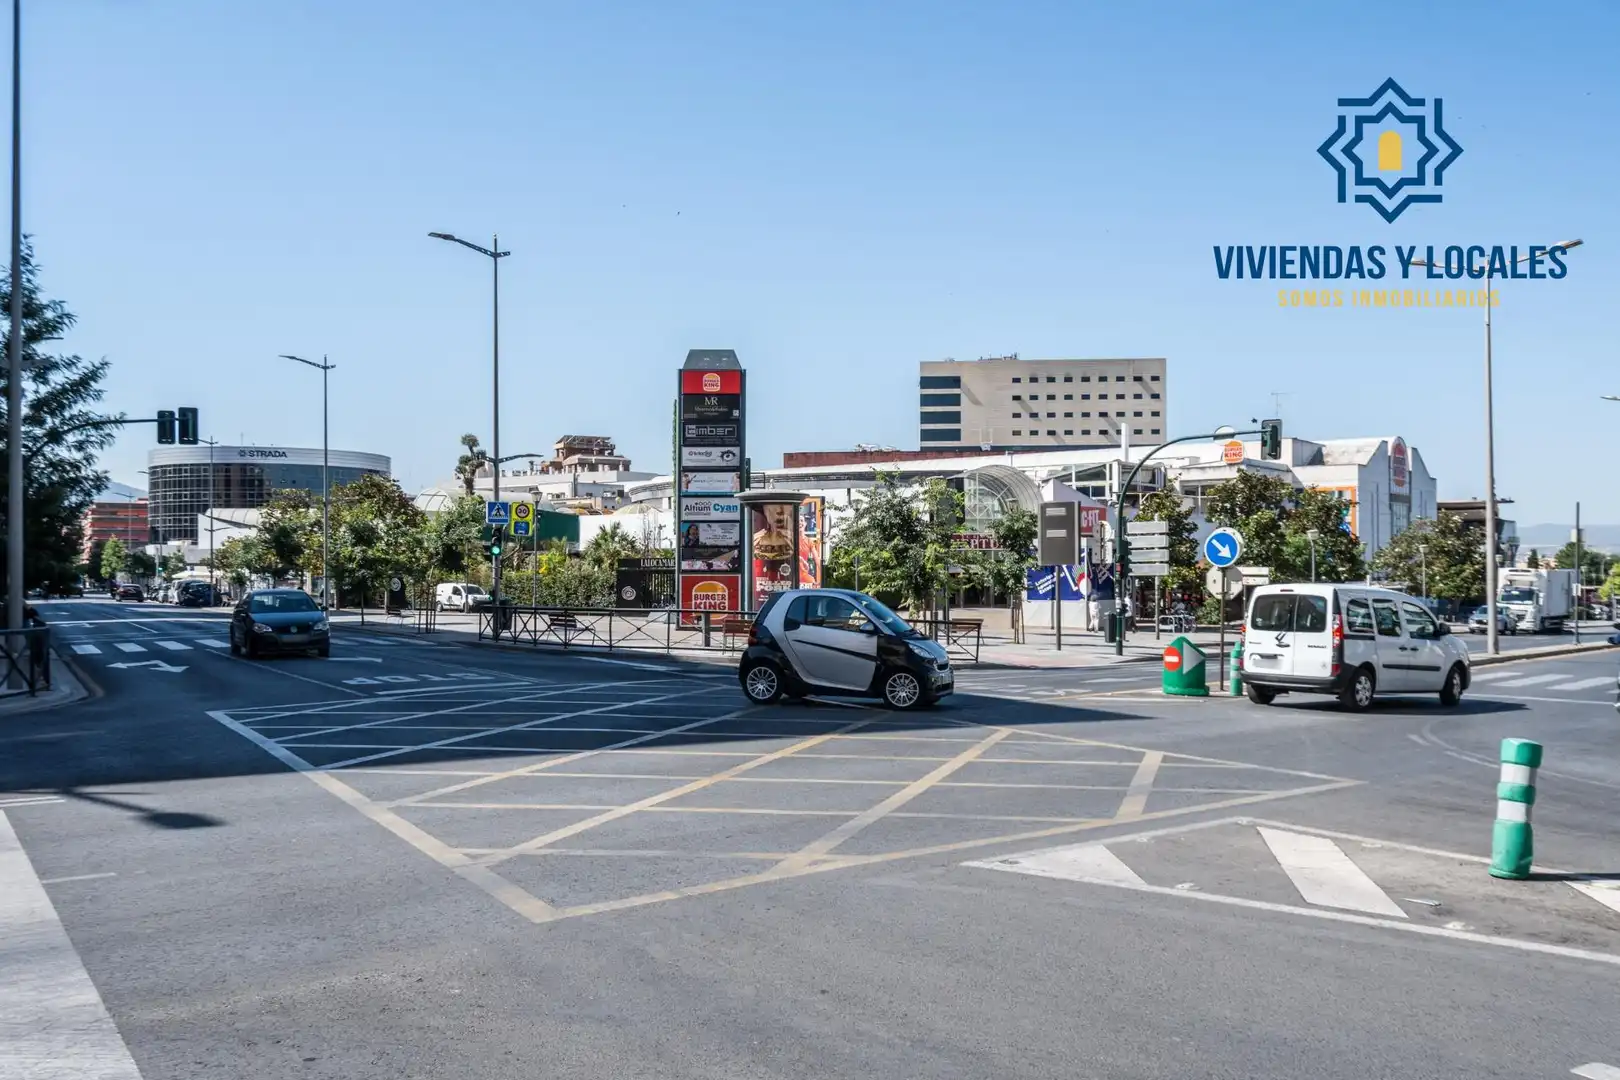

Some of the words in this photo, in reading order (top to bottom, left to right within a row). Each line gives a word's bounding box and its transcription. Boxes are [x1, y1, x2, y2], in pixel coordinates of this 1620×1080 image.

[249, 450, 288, 458] STRADA
[684, 503, 711, 512] Altium
[713, 503, 738, 513] Cyan
[693, 593, 727, 601] BURGER
[693, 601, 727, 611] KING
